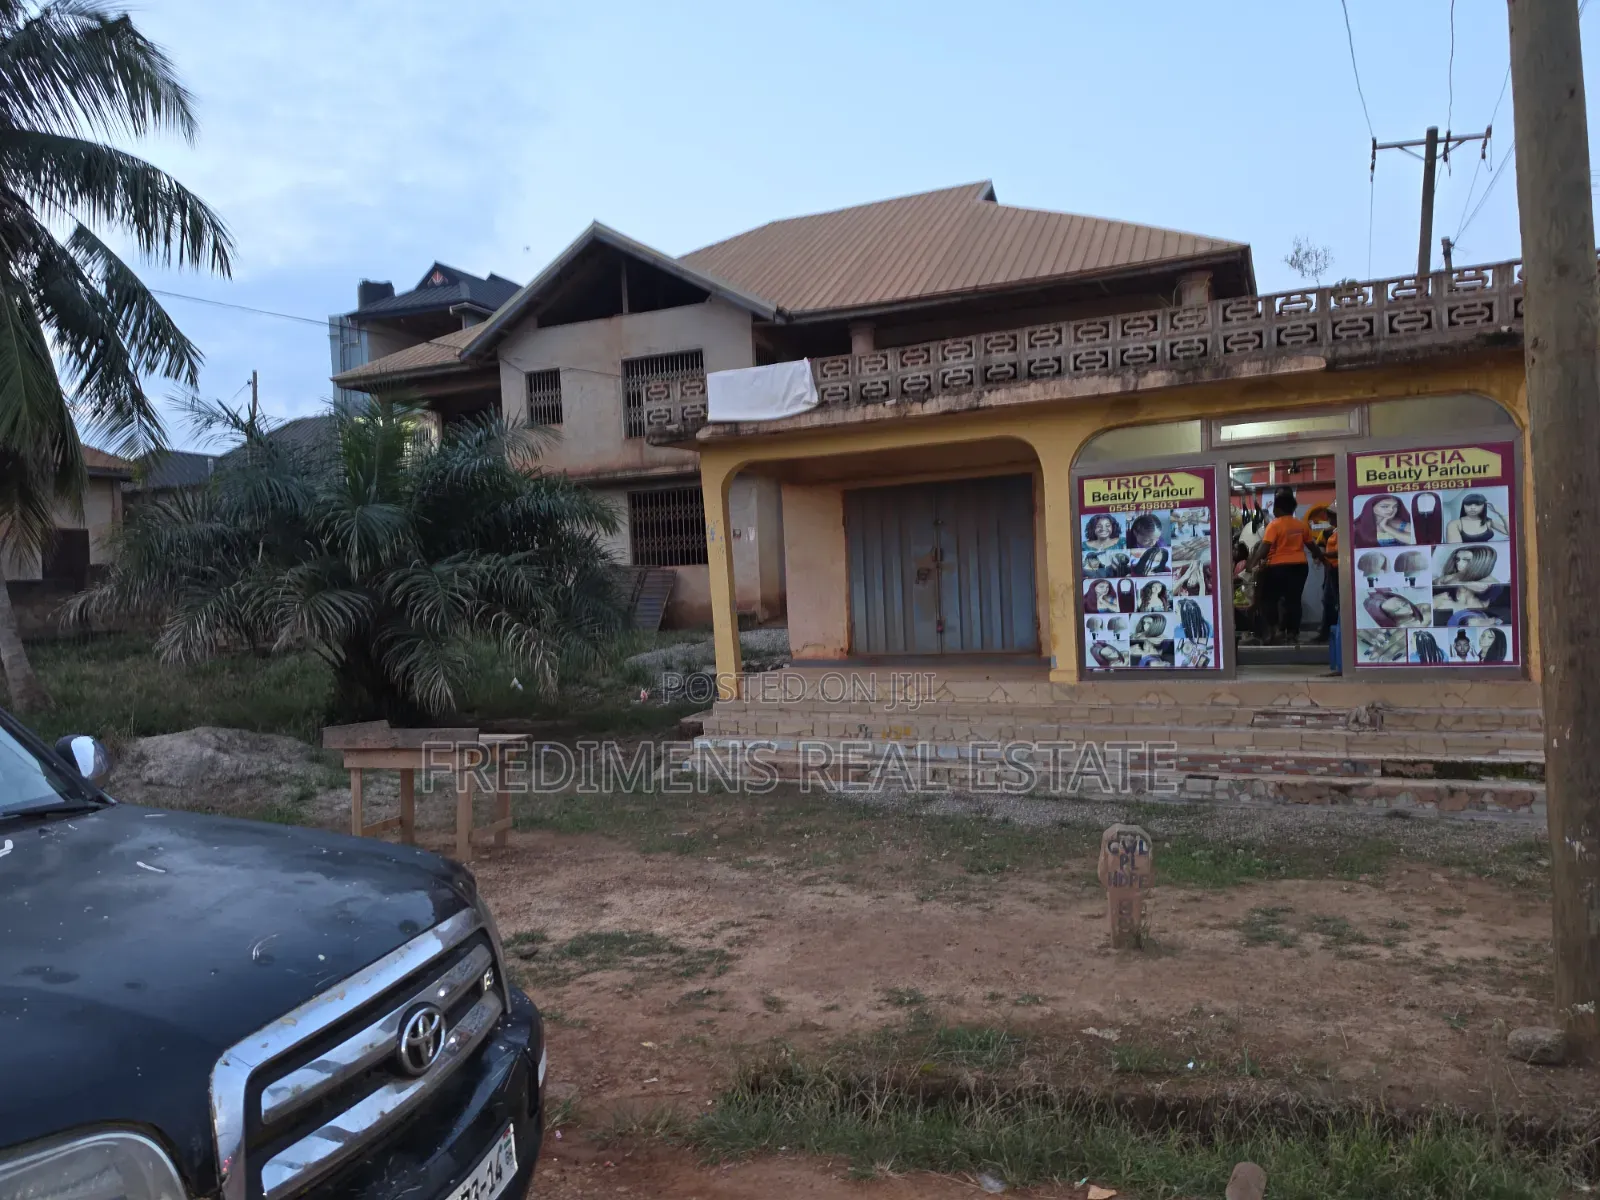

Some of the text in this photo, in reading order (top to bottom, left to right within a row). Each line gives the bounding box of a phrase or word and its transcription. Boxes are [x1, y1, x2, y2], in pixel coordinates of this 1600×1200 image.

[1379, 449, 1466, 469] TRICIA
[1366, 463, 1490, 482] Beauty Parlour
[1103, 474, 1175, 491] TRICIA
[1387, 479, 1473, 492] 0545 498031
[1092, 486, 1195, 503] Beauty Parlour
[1109, 500, 1181, 512] 0545 498031
